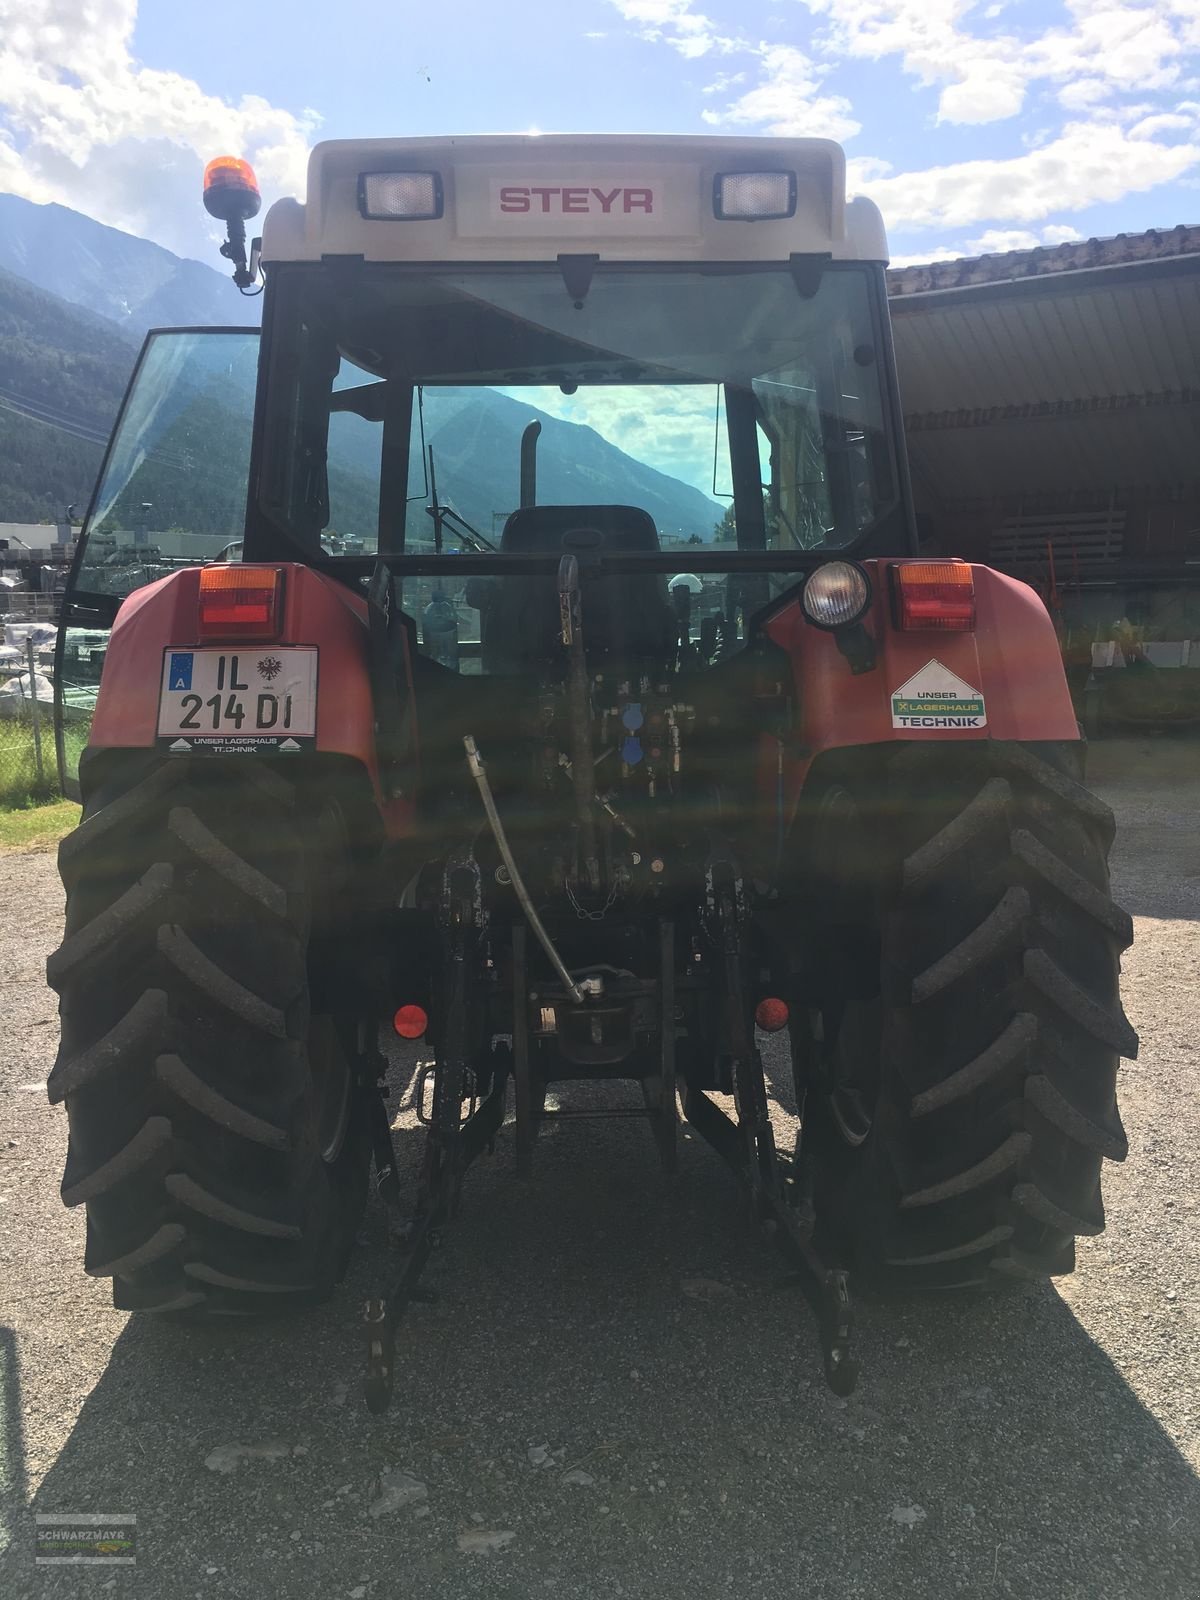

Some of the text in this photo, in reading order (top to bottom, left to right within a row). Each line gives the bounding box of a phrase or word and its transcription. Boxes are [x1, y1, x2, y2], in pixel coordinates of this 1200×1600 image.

[500, 187, 653, 213] STEYR
[217, 656, 248, 690] IL
[175, 678, 185, 688] A
[179, 694, 292, 729] 214 DI
[899, 717, 980, 727] TECHNIK
[225, 737, 278, 745] LAGERHAUS
